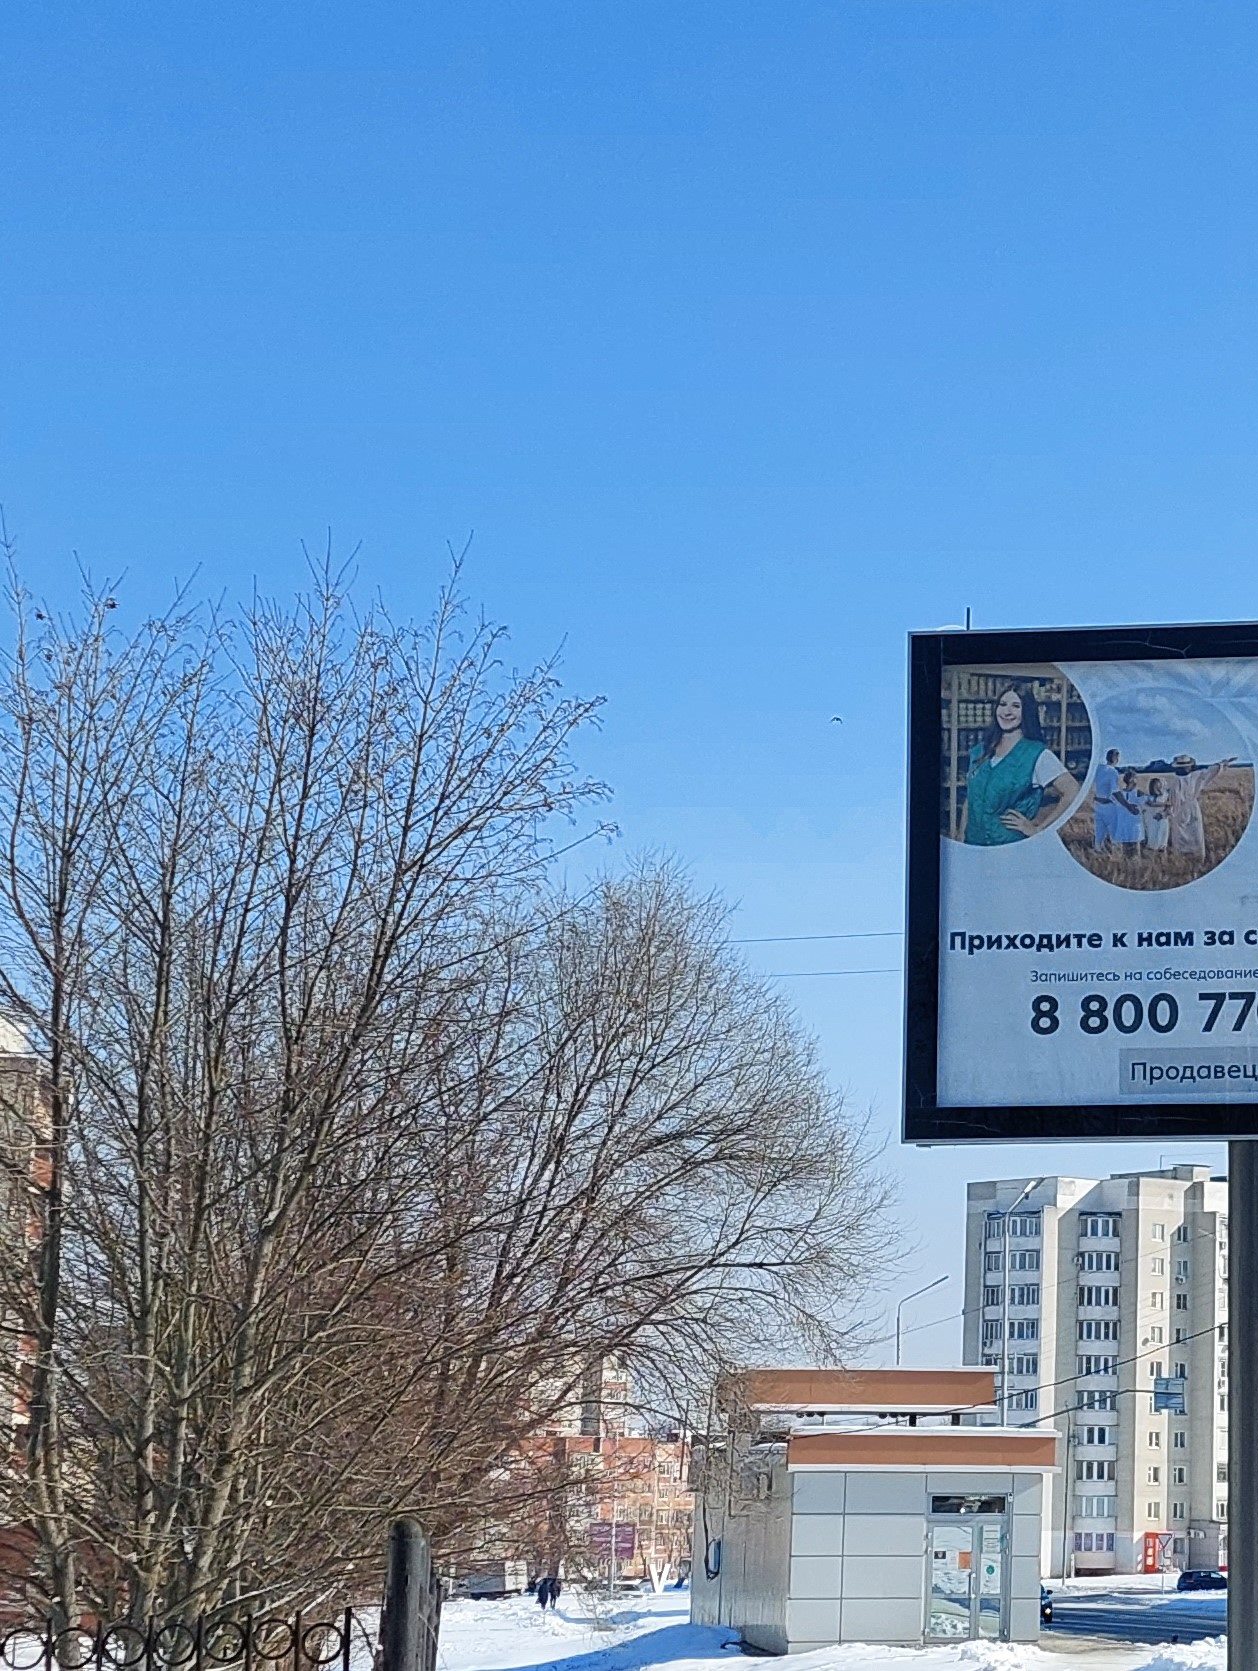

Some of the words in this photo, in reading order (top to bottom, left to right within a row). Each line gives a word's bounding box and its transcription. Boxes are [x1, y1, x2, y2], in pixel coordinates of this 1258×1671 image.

[950, 931, 1103, 955] Приходите
[1111, 932, 1128, 948] к
[1137, 930, 1194, 947] нам
[1203, 929, 1235, 946] за
[1030, 970, 1120, 983] Запишитесь
[1124, 971, 1143, 981] на
[1030, 994, 1060, 1035] 8
[1079, 993, 1179, 1034] 800
